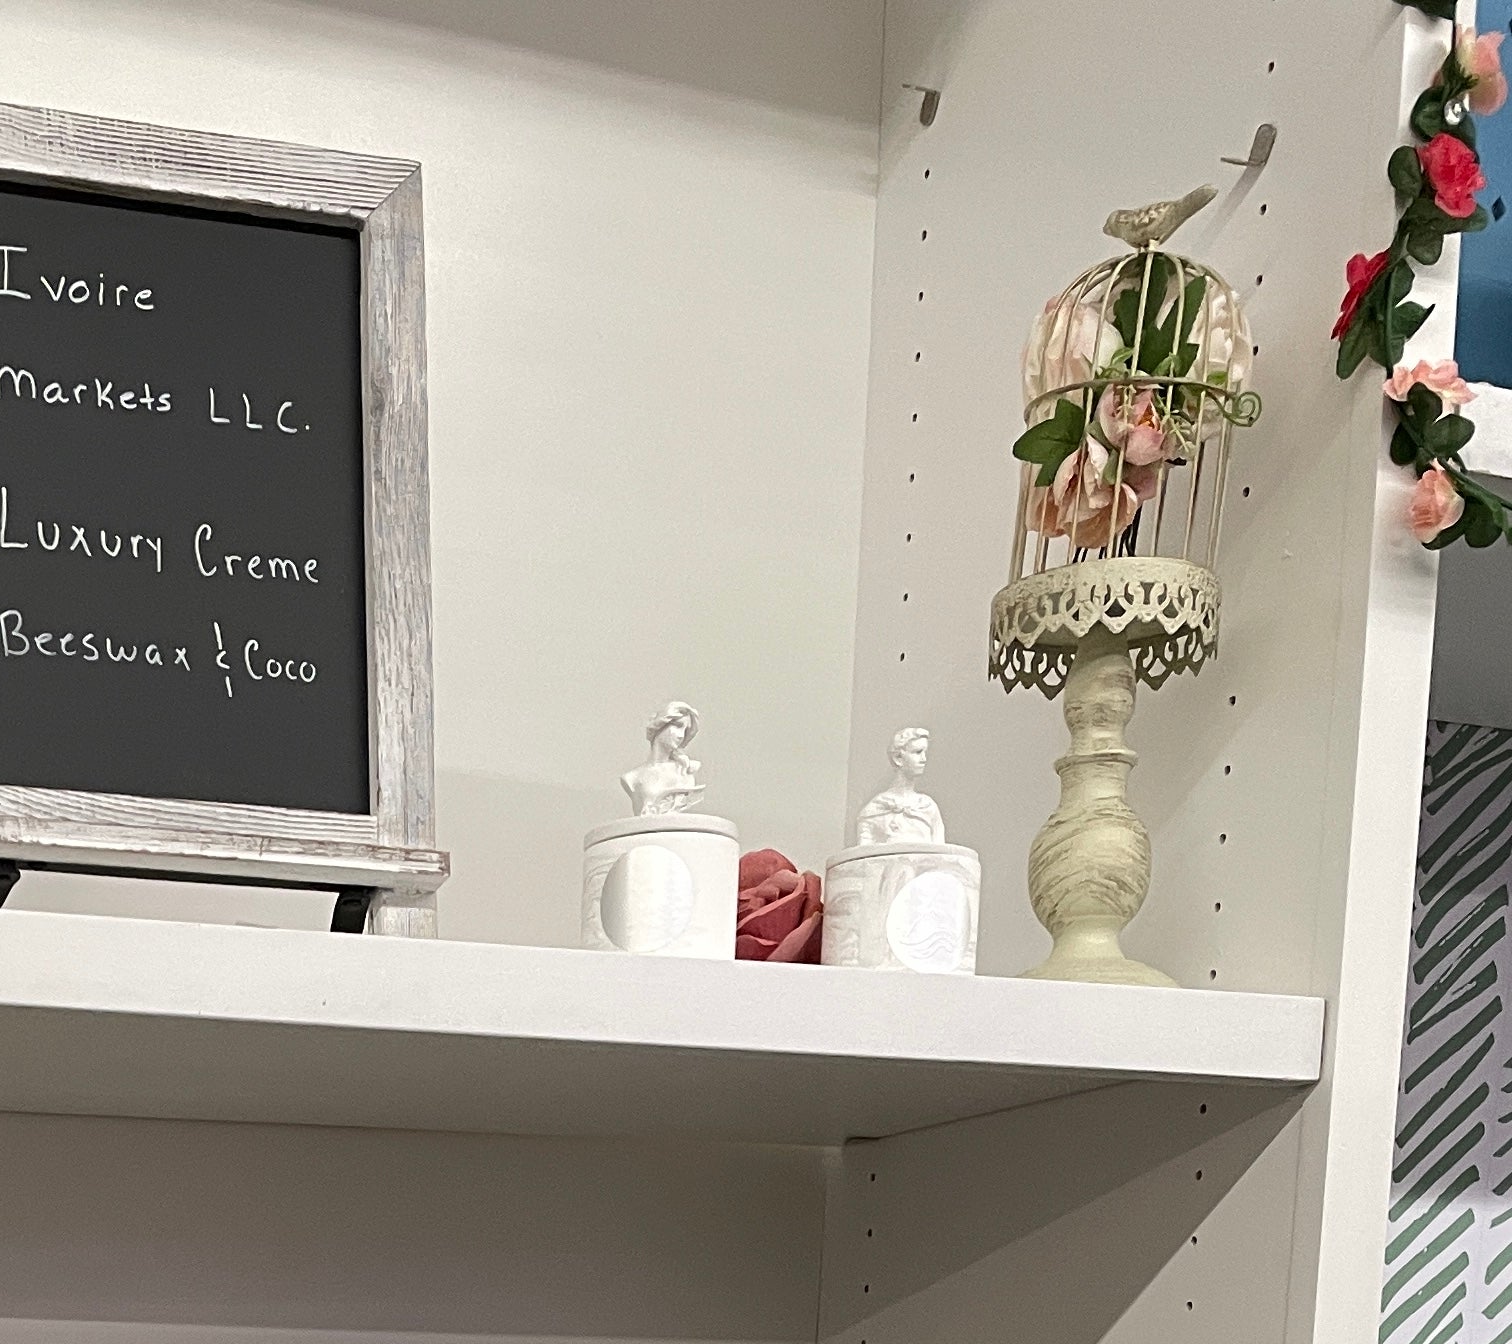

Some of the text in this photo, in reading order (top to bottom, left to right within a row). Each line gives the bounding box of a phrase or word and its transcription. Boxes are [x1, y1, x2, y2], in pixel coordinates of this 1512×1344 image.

[0, 485, 320, 585] Luxury Creme
[0, 610, 191, 672] Beeswax
[244, 637, 318, 685] Coco
